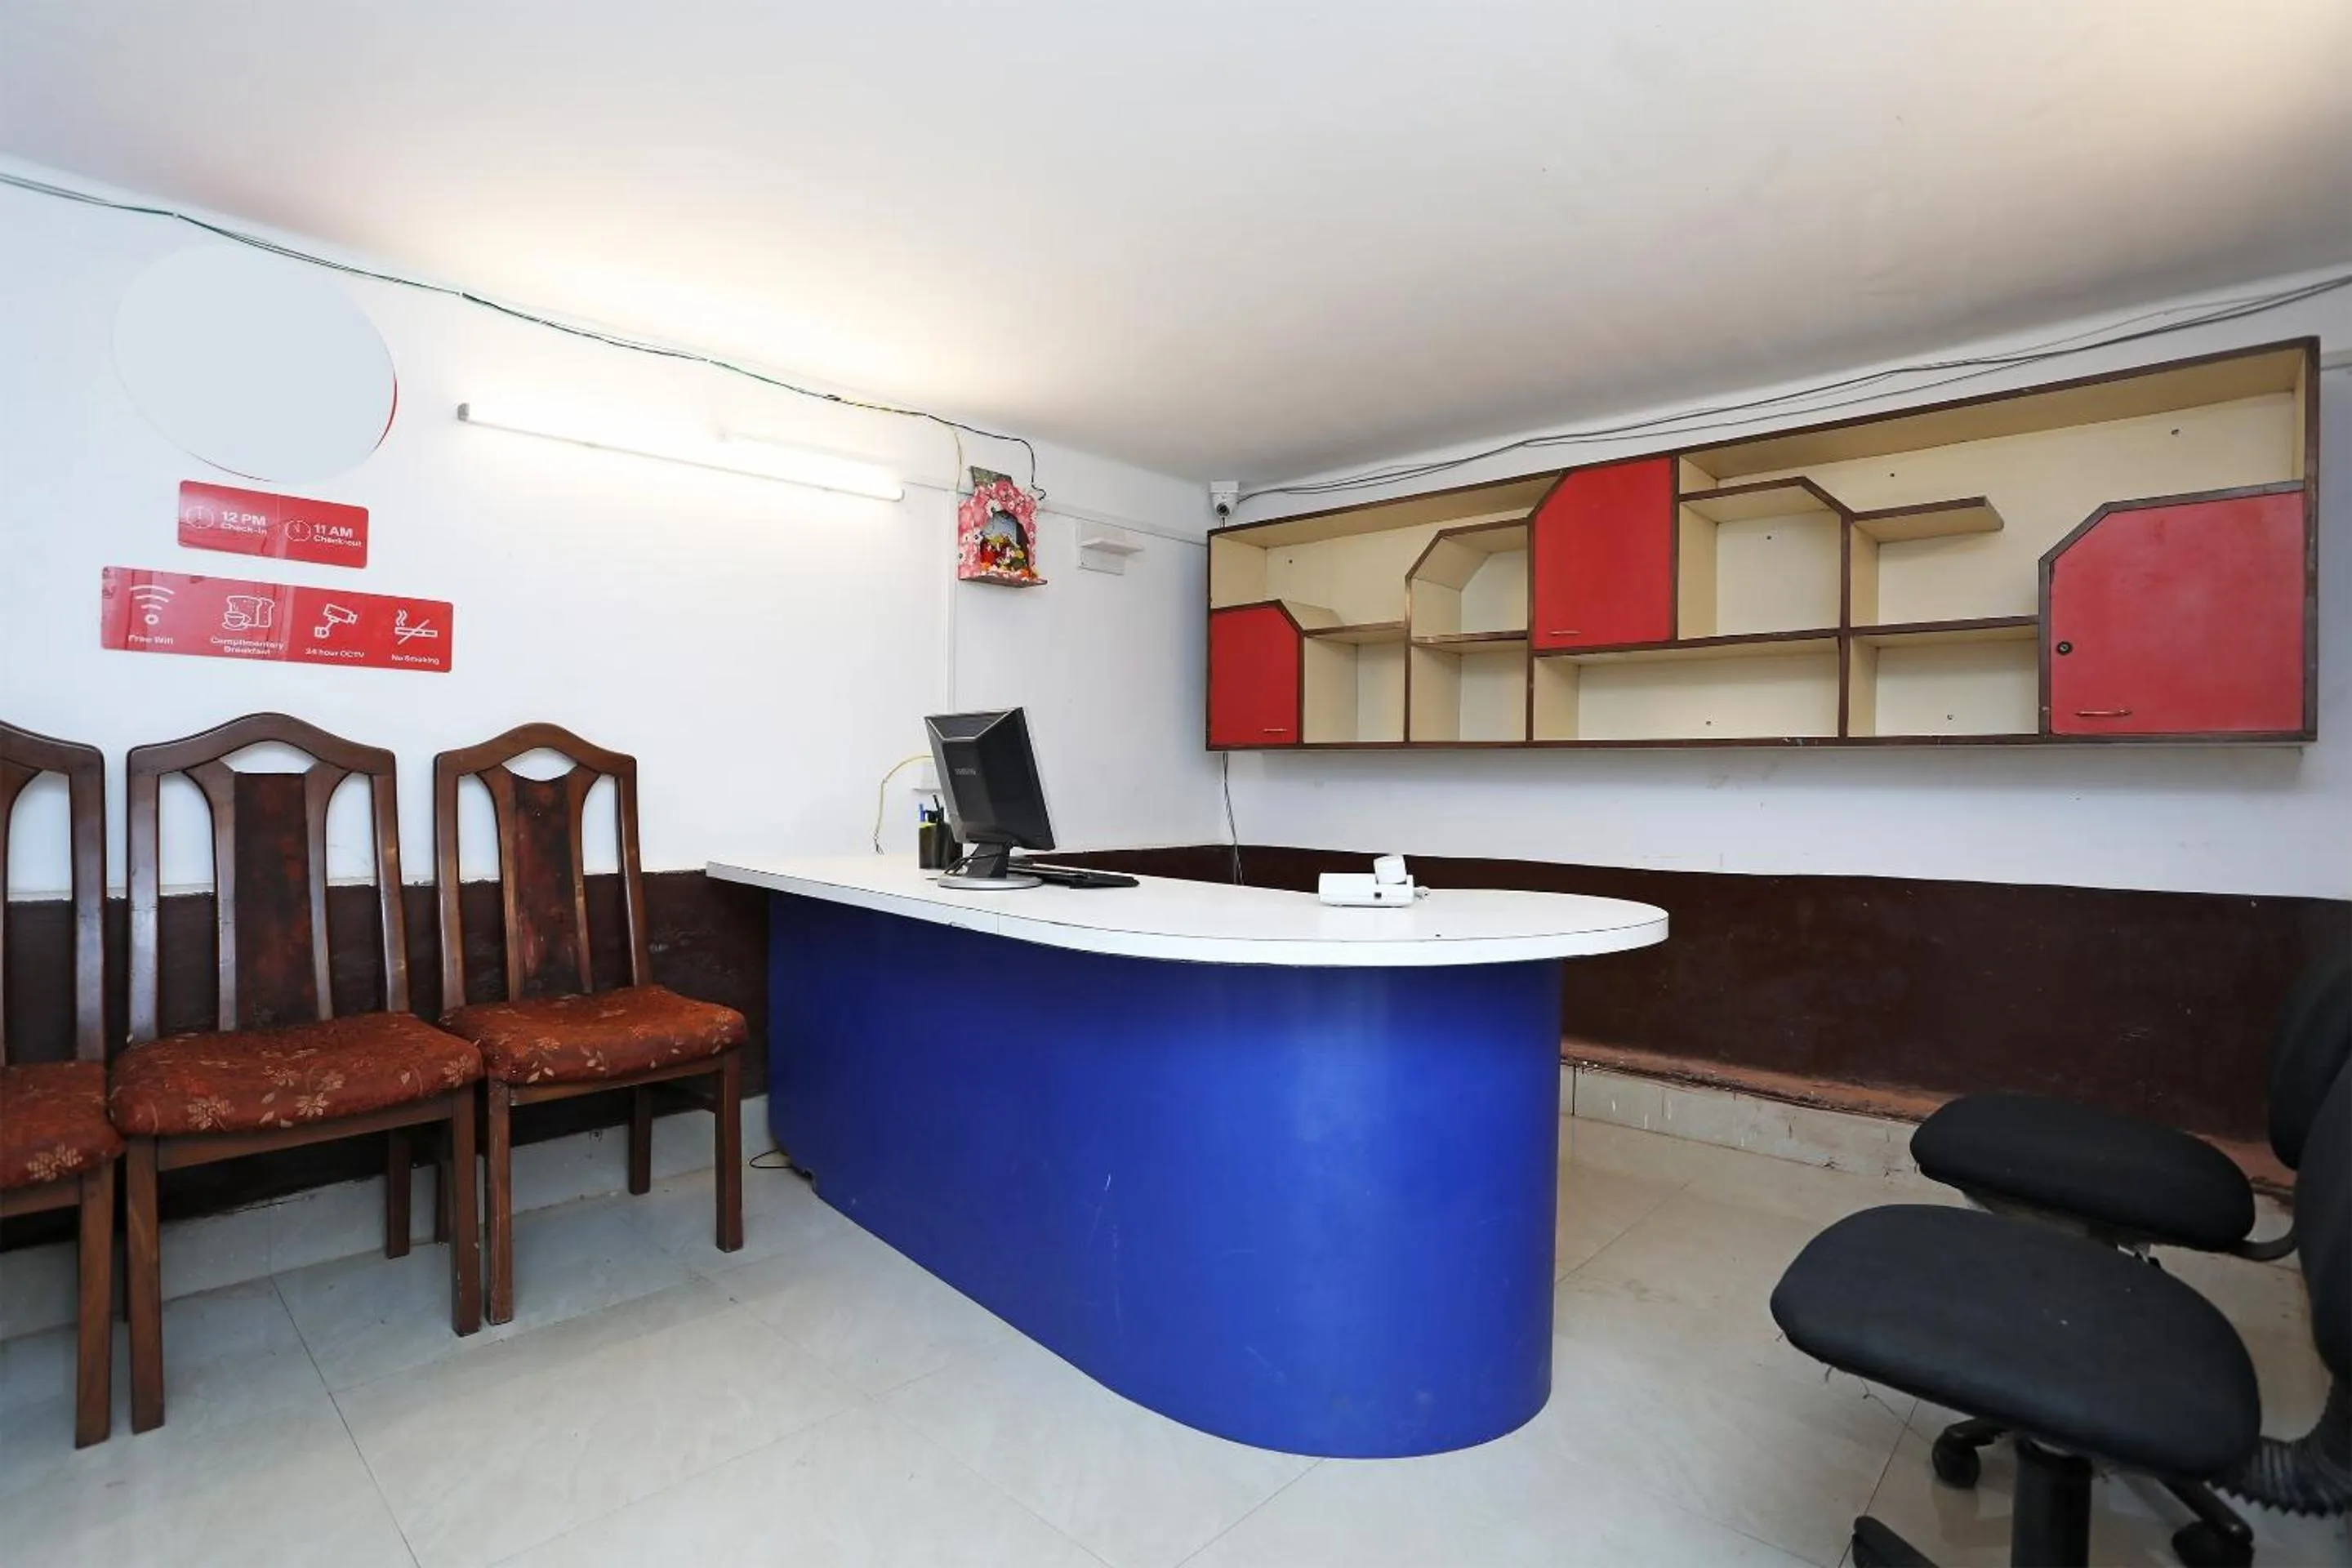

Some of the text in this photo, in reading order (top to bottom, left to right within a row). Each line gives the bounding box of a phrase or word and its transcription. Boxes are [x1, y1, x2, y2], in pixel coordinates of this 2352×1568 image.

[222, 511, 266, 527] 12 PM
[314, 523, 354, 538] 11 AM
